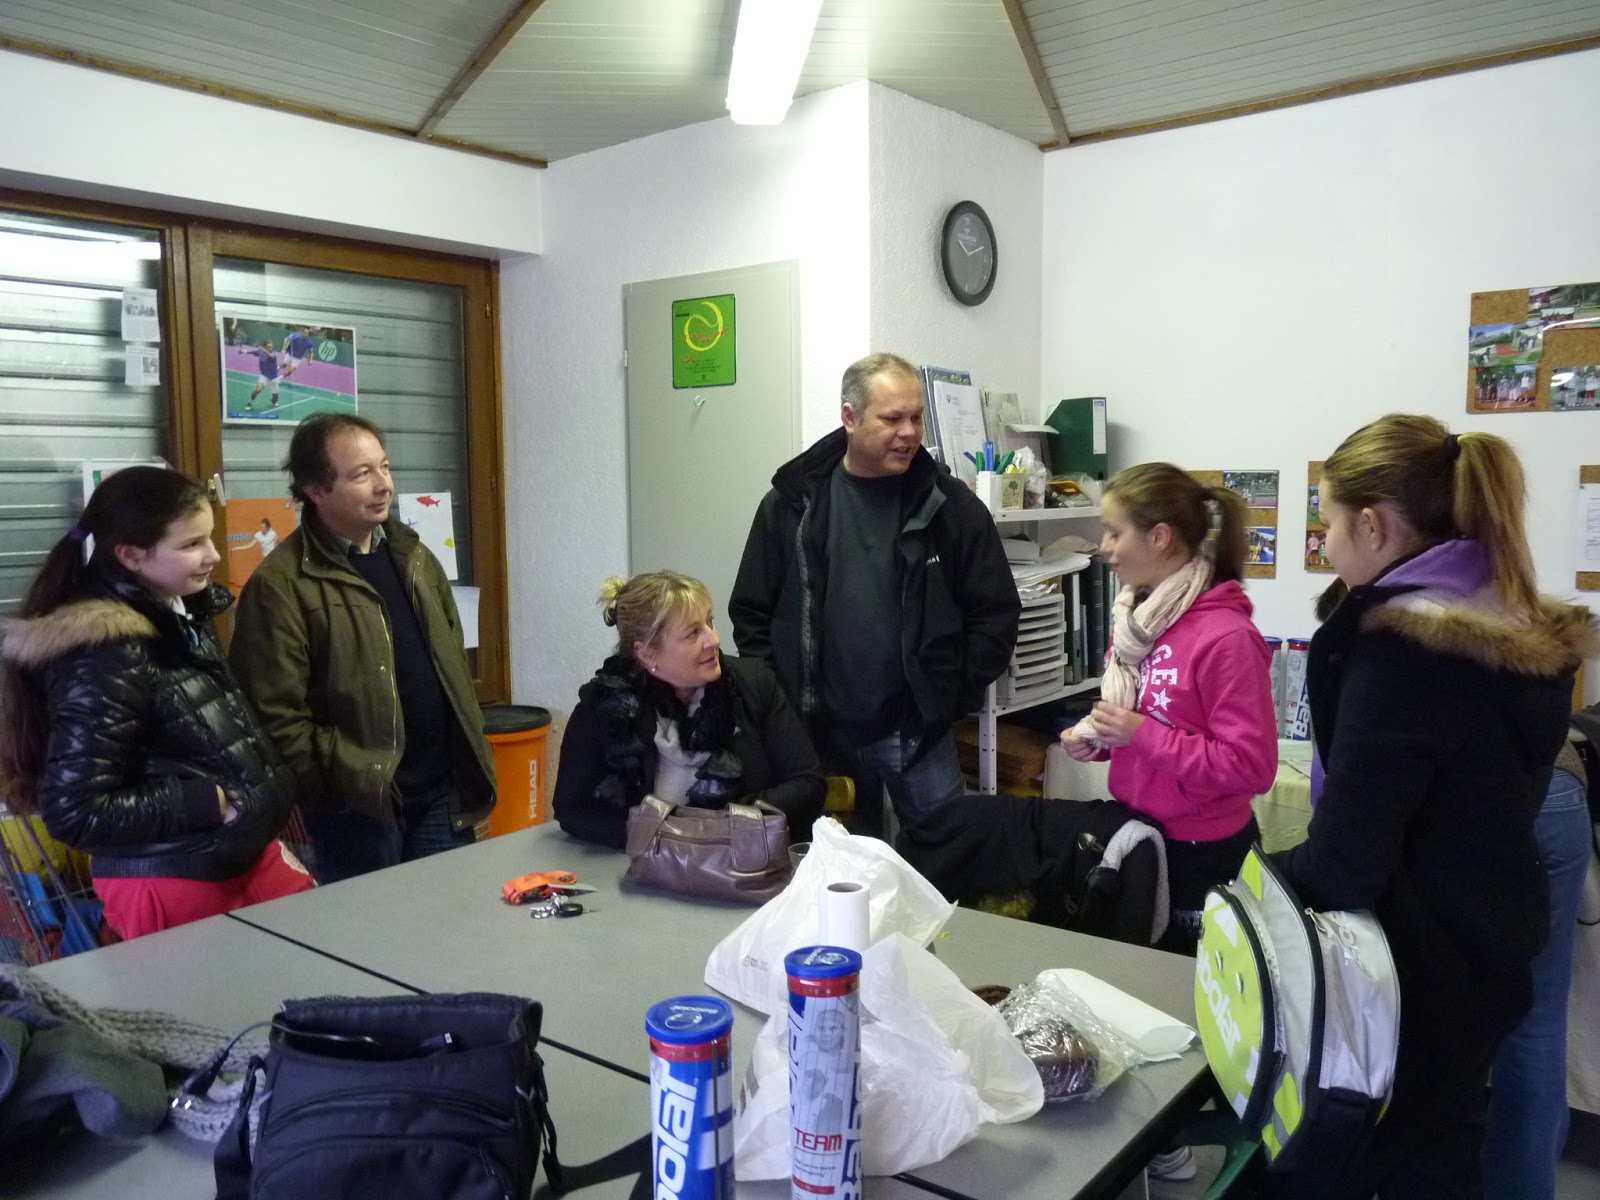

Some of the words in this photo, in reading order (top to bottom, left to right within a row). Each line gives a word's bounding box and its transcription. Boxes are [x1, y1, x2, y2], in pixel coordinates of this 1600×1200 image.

[320, 341, 336, 361] hp
[529, 759, 538, 819] HEAD
[794, 1127, 843, 1152] TEAM
